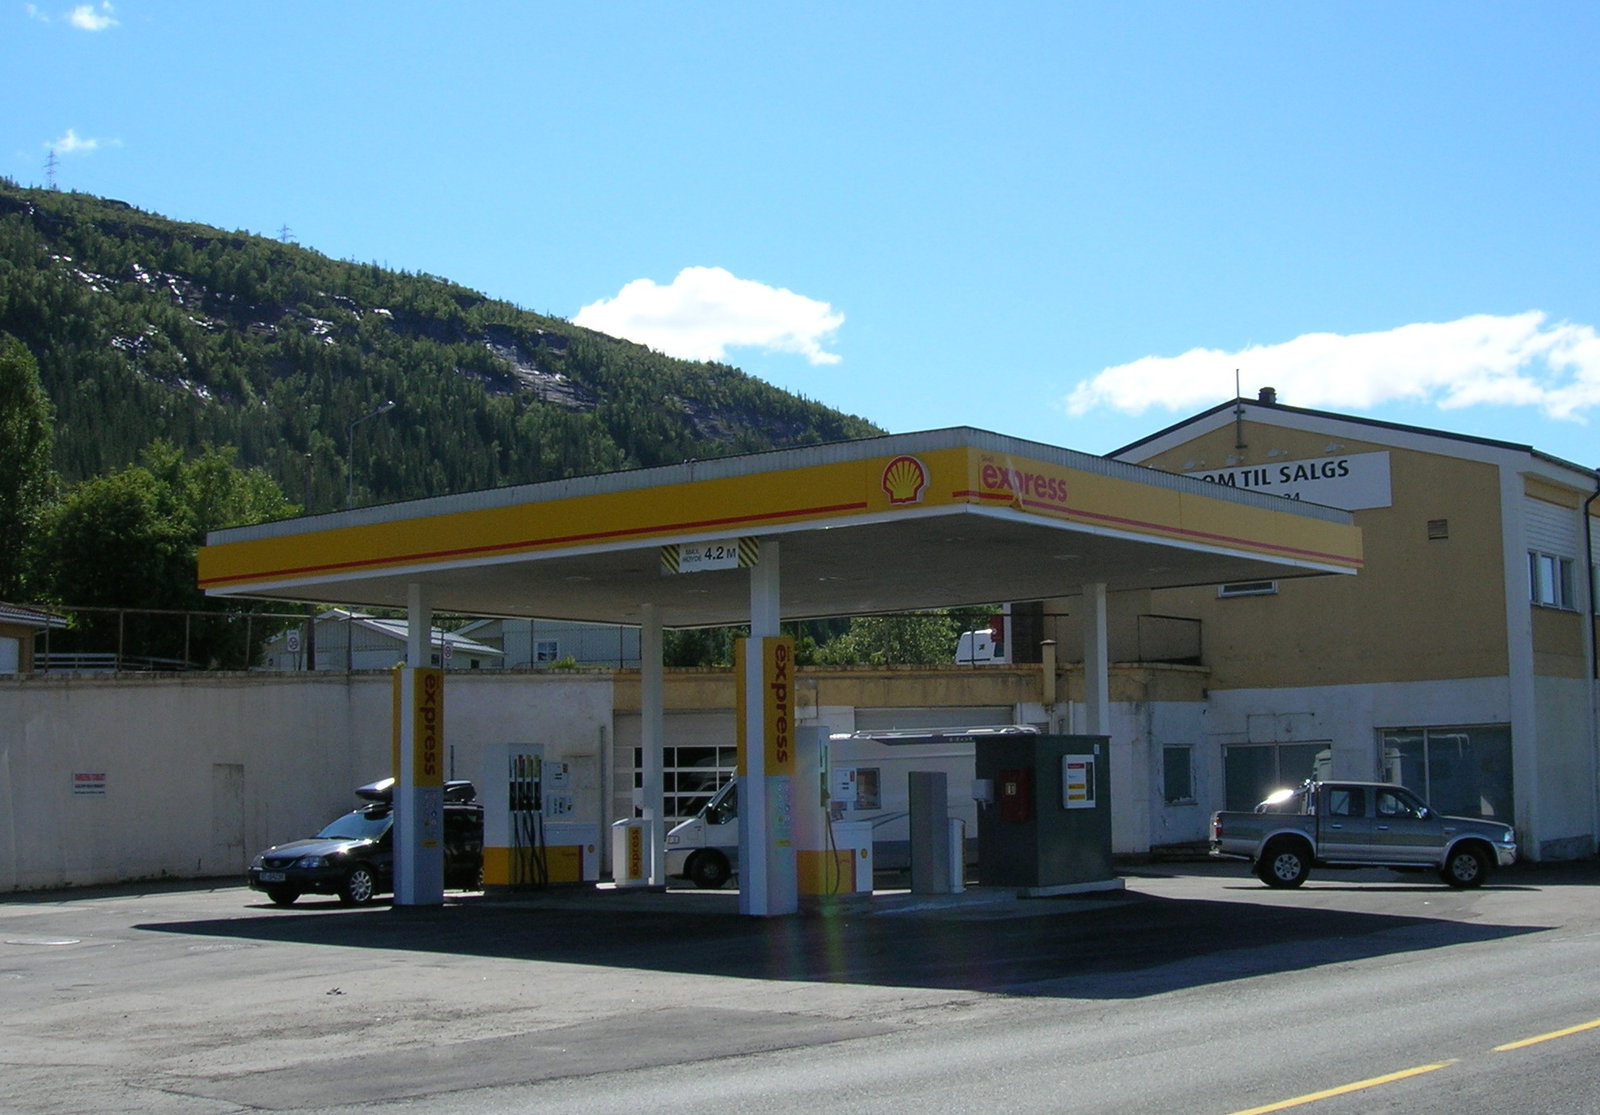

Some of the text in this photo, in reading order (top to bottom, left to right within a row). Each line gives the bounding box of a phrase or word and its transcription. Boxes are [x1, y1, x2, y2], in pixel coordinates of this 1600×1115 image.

[982, 464, 1067, 502] express
[1241, 469, 1271, 487] TIL
[1279, 459, 1349, 483] SALGS
[704, 546, 724, 560] 4.2
[726, 548, 736, 559] M
[771, 644, 788, 763] express
[420, 673, 435, 775] express
